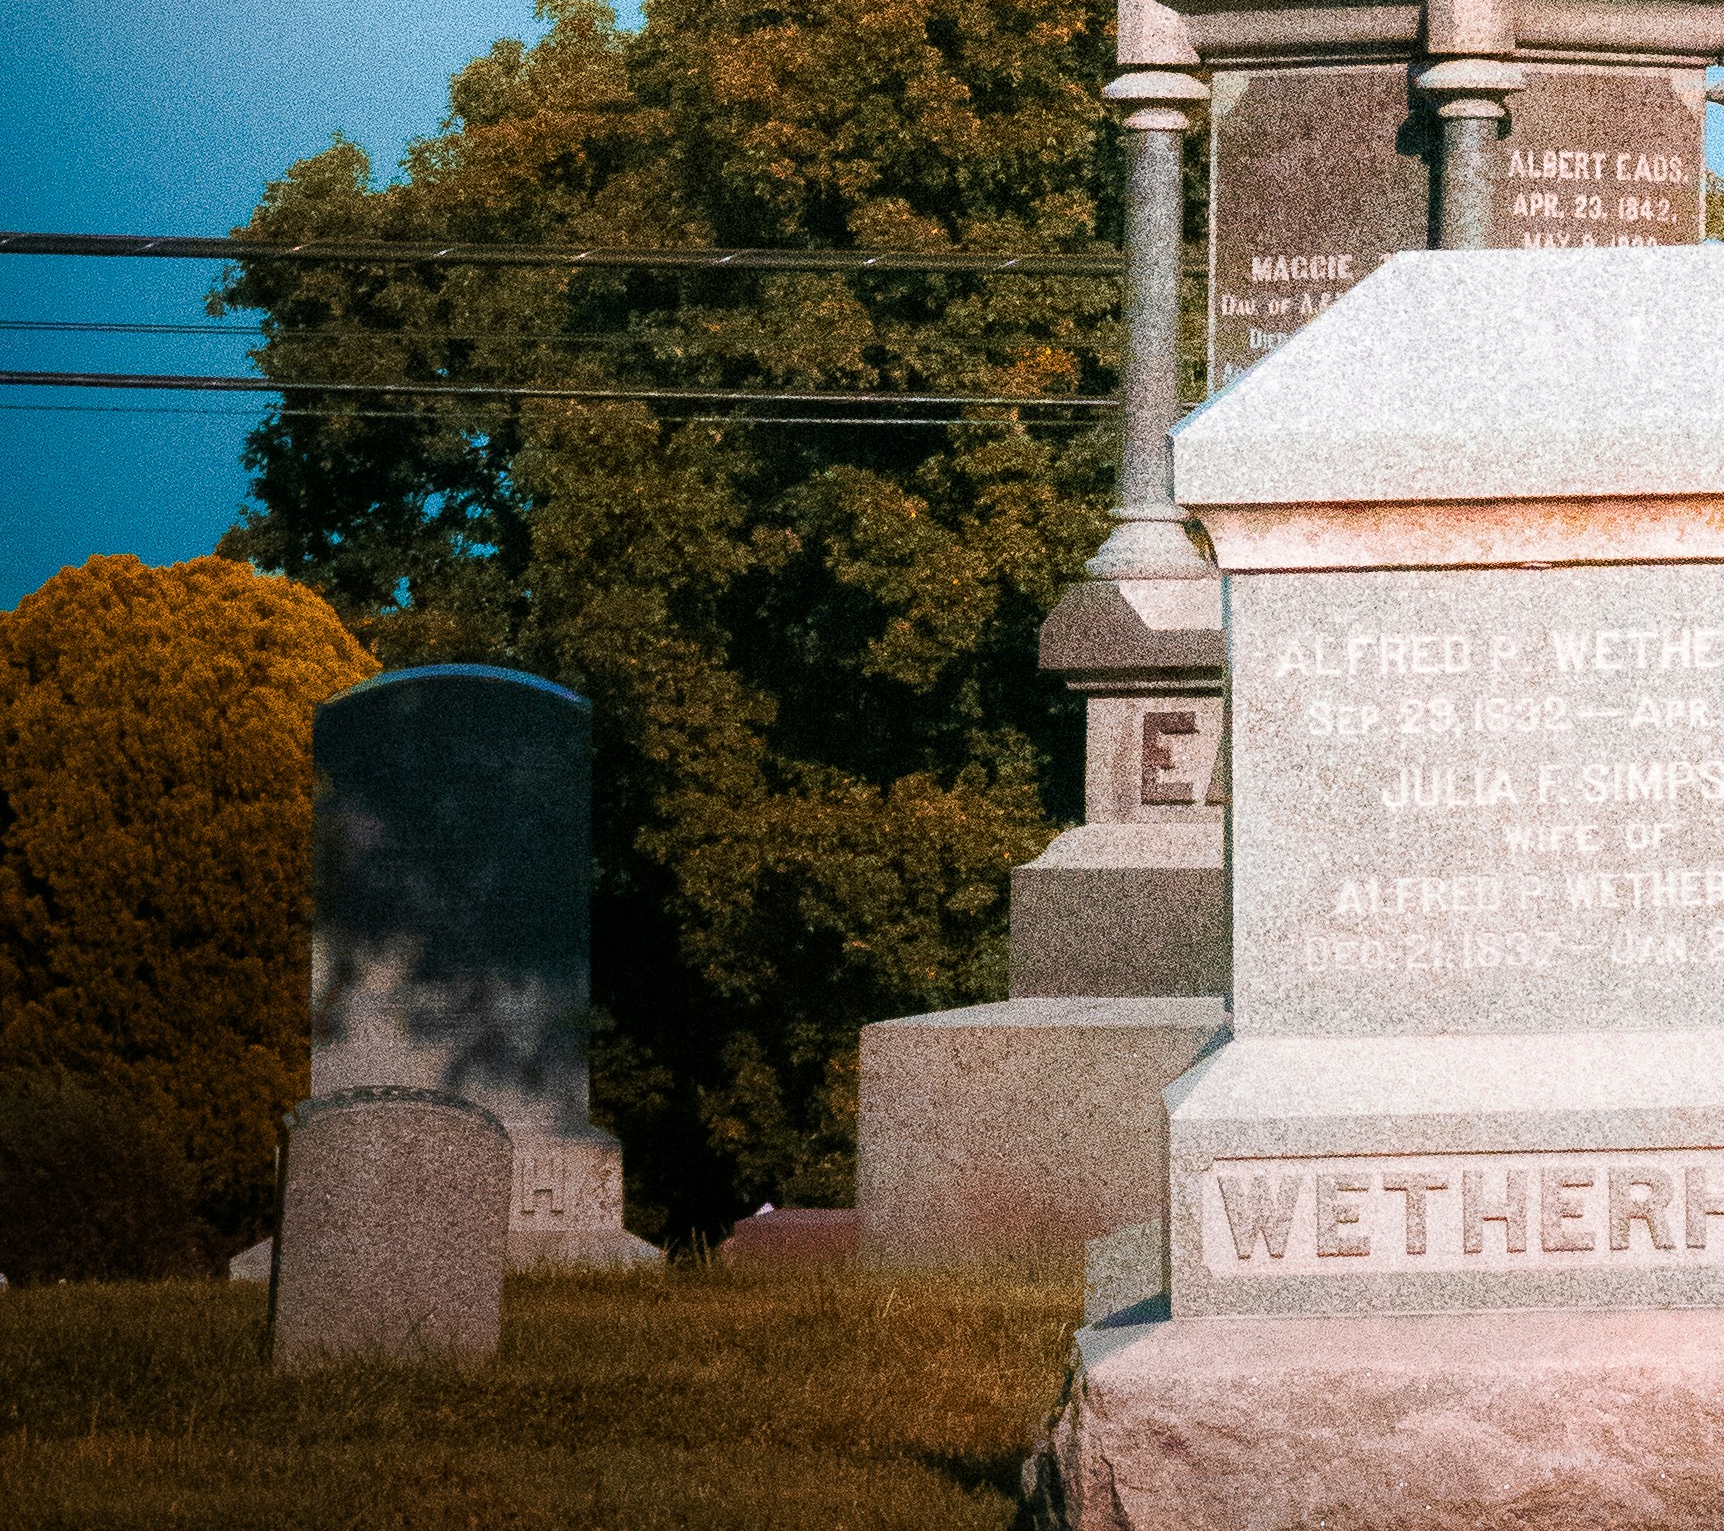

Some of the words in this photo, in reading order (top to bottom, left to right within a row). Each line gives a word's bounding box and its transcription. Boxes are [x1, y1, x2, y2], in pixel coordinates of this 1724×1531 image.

[1508, 149, 1606, 180] ALBERT
[1251, 254, 1354, 282] MAGGIE
[1275, 633, 1472, 678] ALFRED
[1381, 767, 1518, 811] JULIA
[1505, 823, 1603, 854] WIFE
[1626, 822, 1677, 852] OF
[1333, 875, 1502, 916] ALFRED
